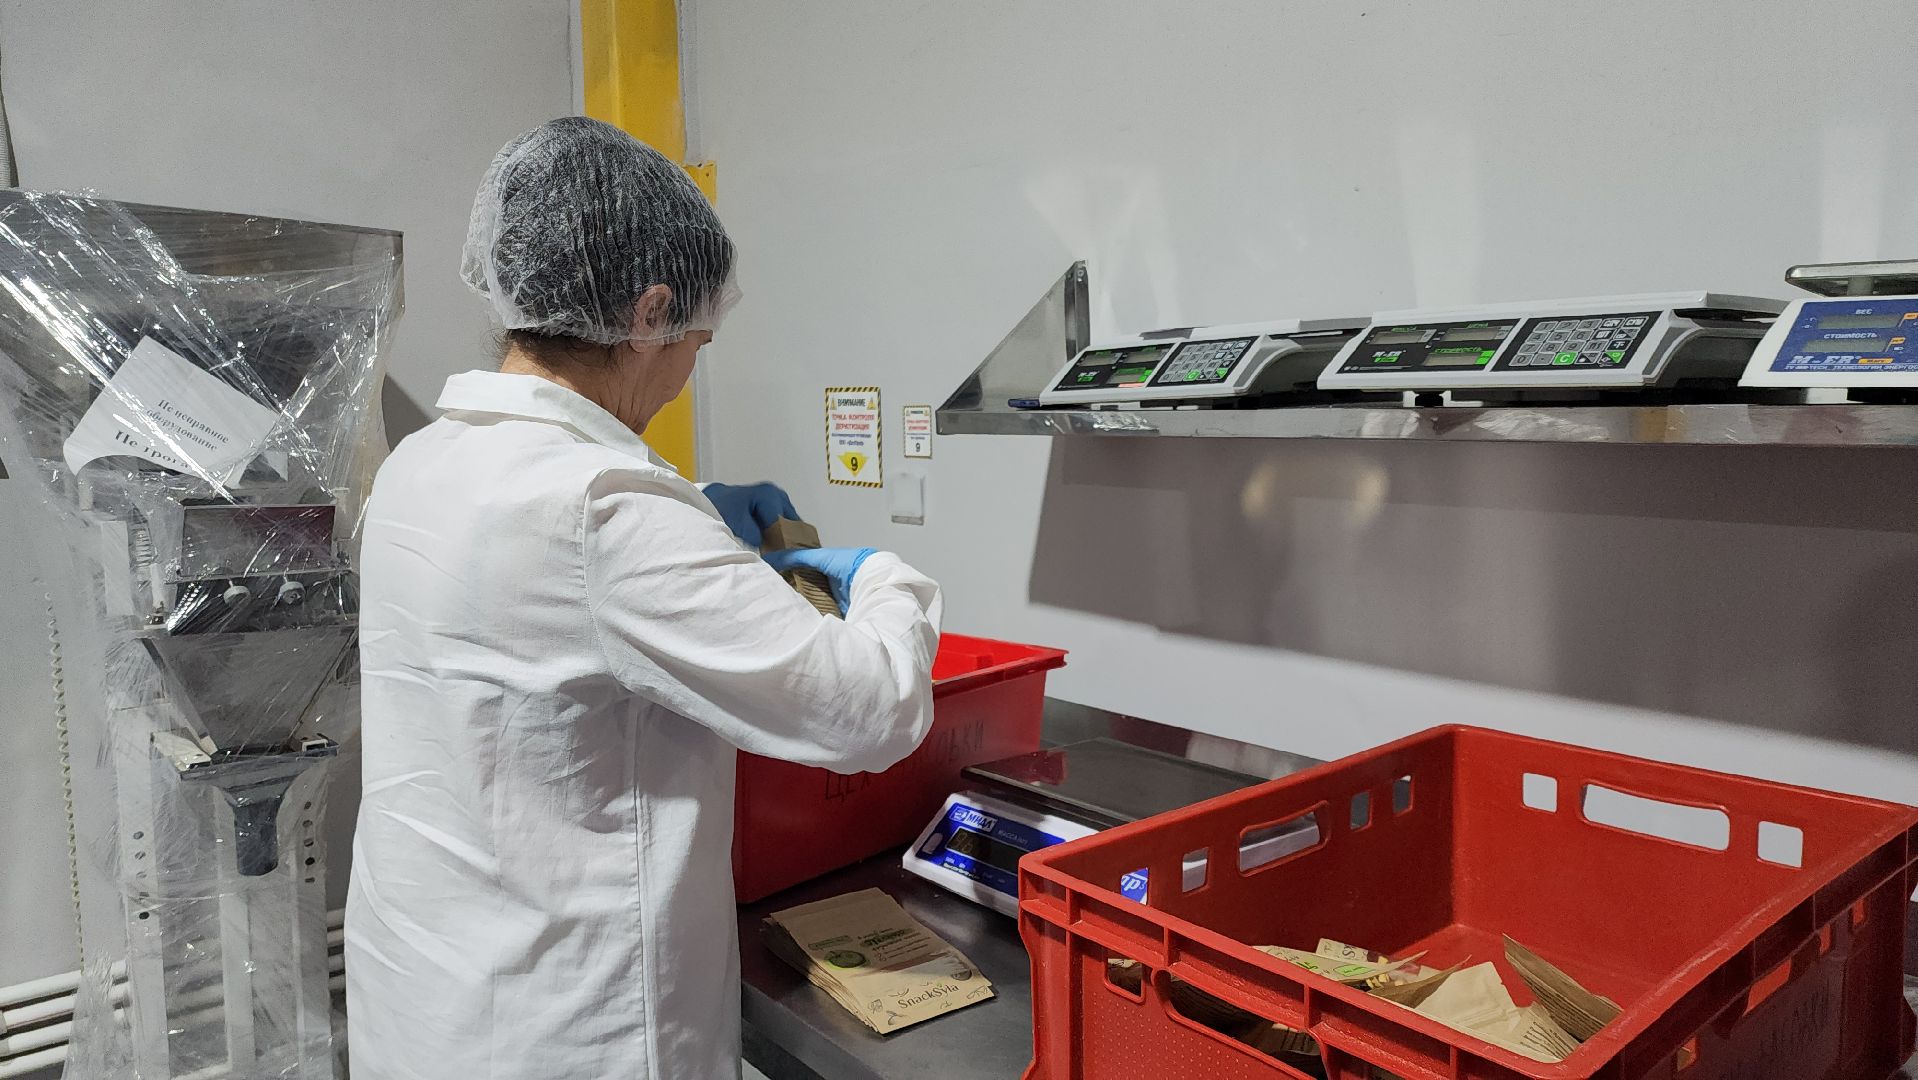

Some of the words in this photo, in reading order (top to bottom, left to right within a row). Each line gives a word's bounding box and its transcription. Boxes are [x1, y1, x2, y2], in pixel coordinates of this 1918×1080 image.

[158, 399, 175, 413] Не
[837, 398, 866, 407] ВНИМАНИЕ
[146, 409, 218, 452] оборудование
[114, 430, 138, 448] Не
[915, 442, 921, 453] 9
[851, 457, 858, 471] 9
[897, 984, 960, 1010] SnackSyla
